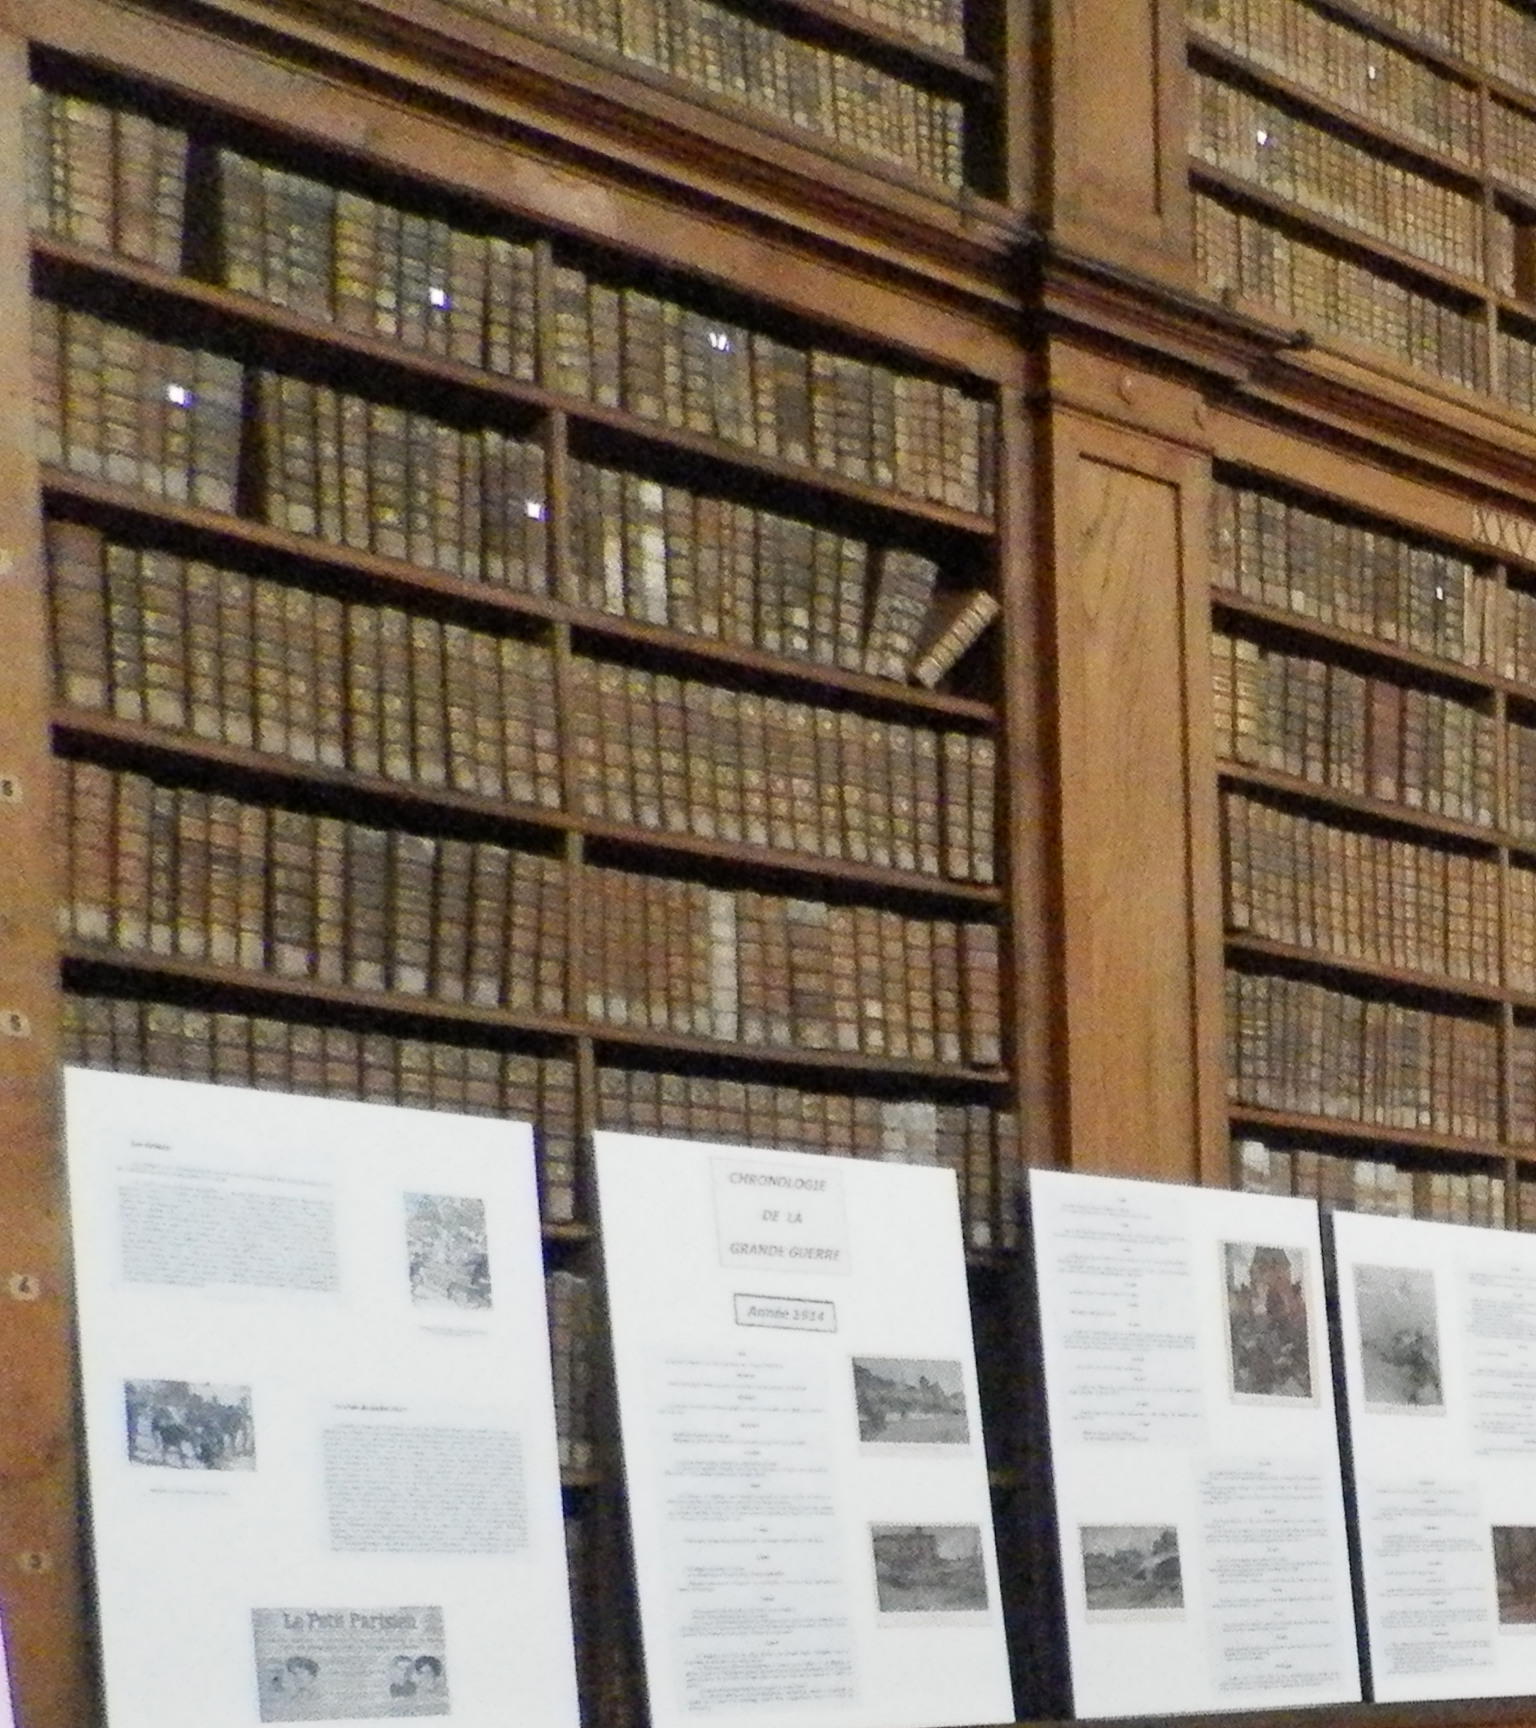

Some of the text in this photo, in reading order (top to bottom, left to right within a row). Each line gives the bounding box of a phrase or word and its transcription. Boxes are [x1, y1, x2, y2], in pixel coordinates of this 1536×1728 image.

[729, 1172, 827, 1192] CHRONOLOGIE
[762, 1210, 803, 1224] DE LA
[730, 1243, 840, 1261] GRANDE GUERRE
